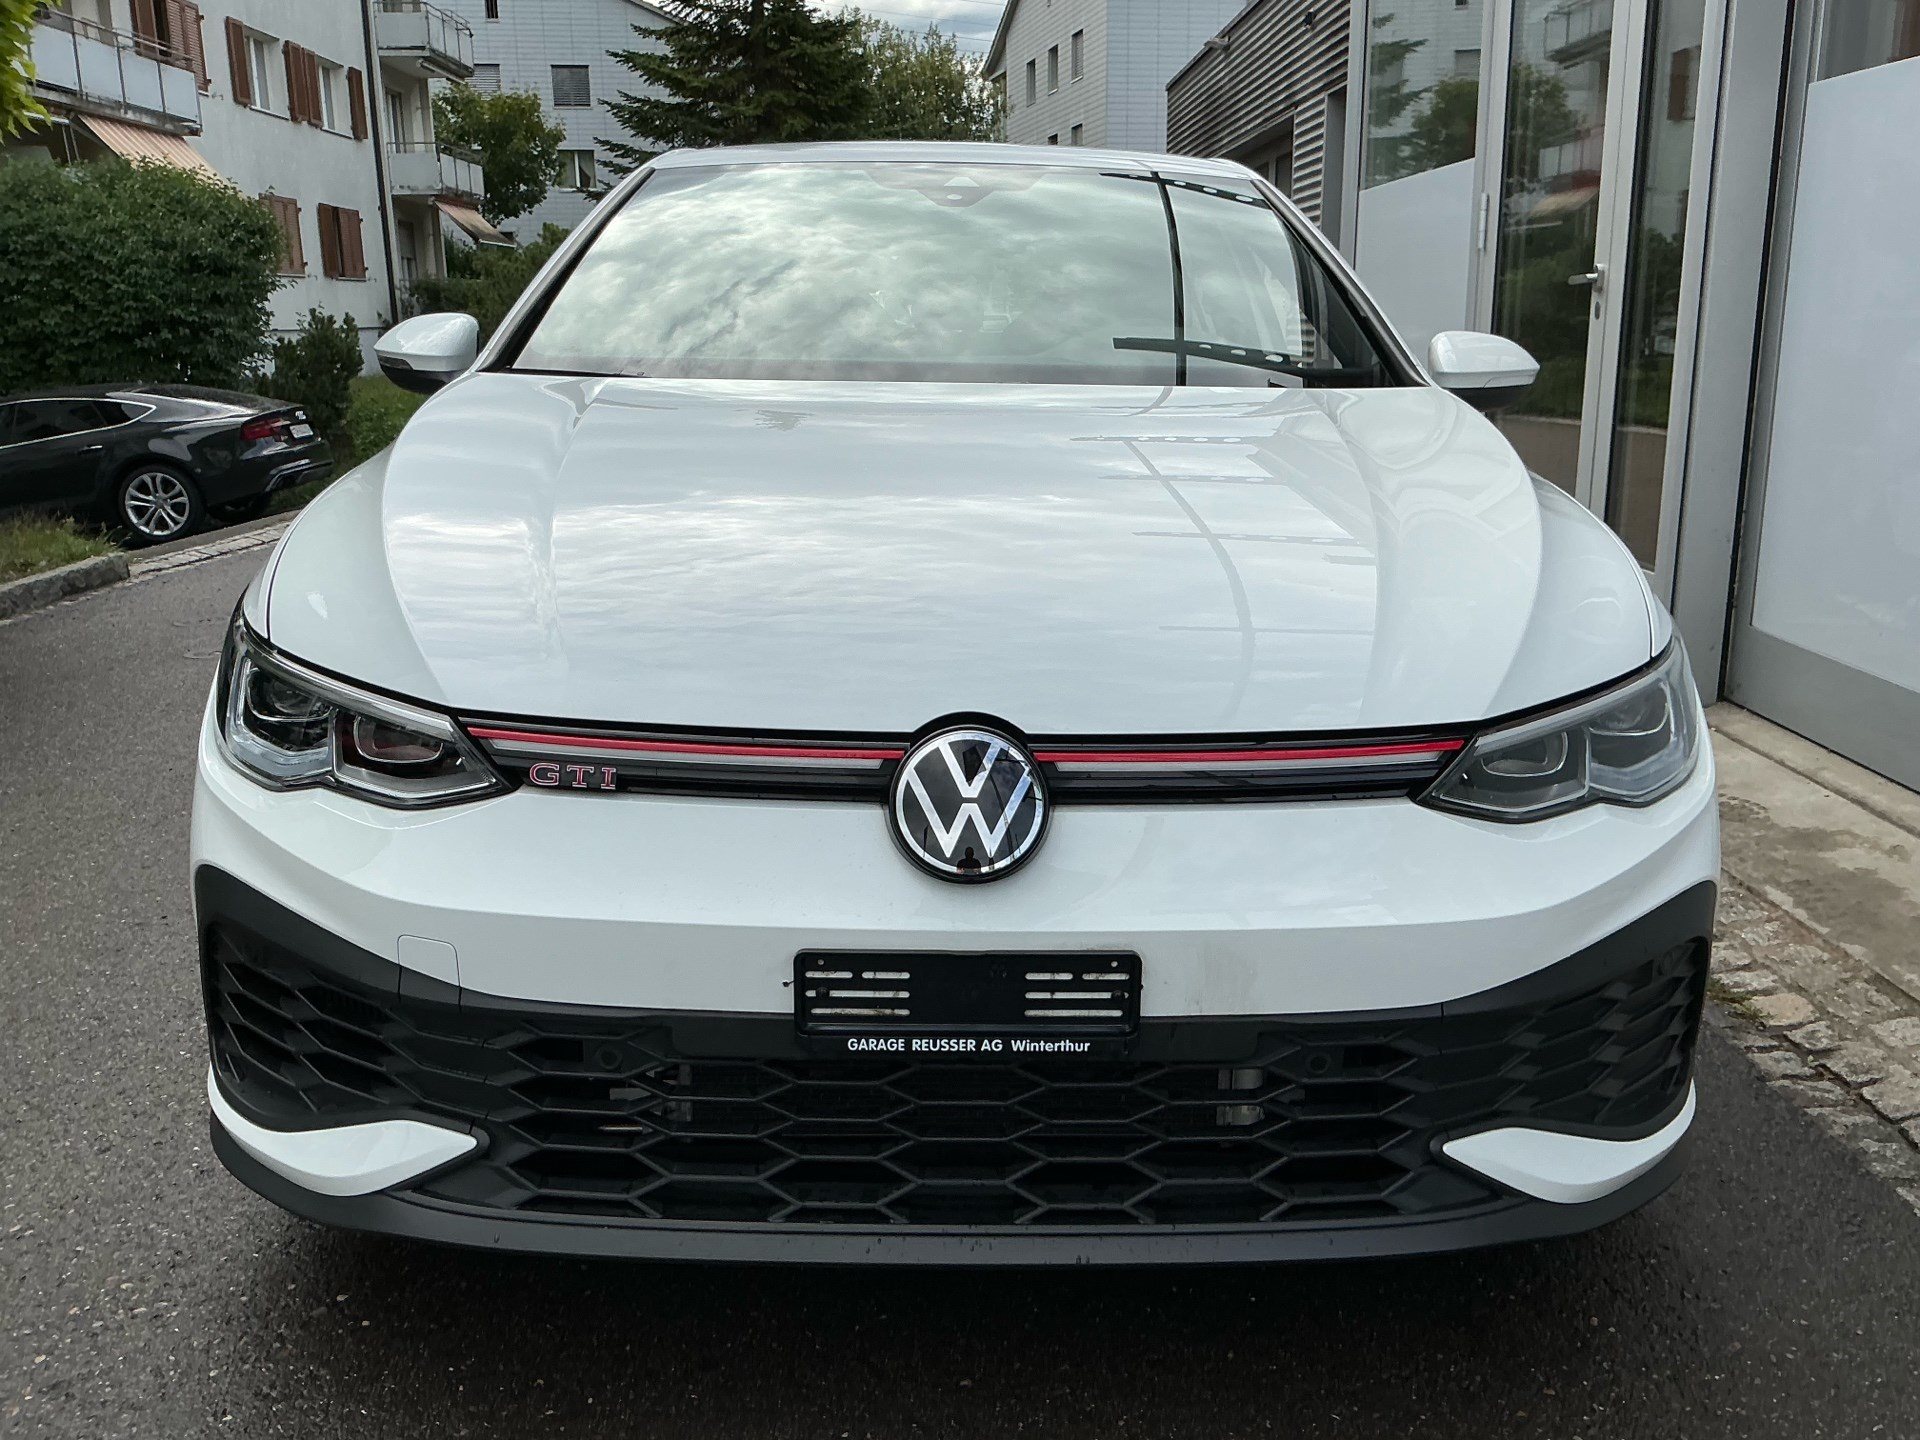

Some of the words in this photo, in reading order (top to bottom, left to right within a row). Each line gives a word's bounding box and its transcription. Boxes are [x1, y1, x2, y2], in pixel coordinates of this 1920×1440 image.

[529, 762, 617, 790] GTI
[847, 1038, 905, 1051] GARAGE
[911, 1038, 976, 1052] REUSSER
[980, 1039, 1003, 1052] AG
[1010, 1039, 1091, 1053] Winterthur
